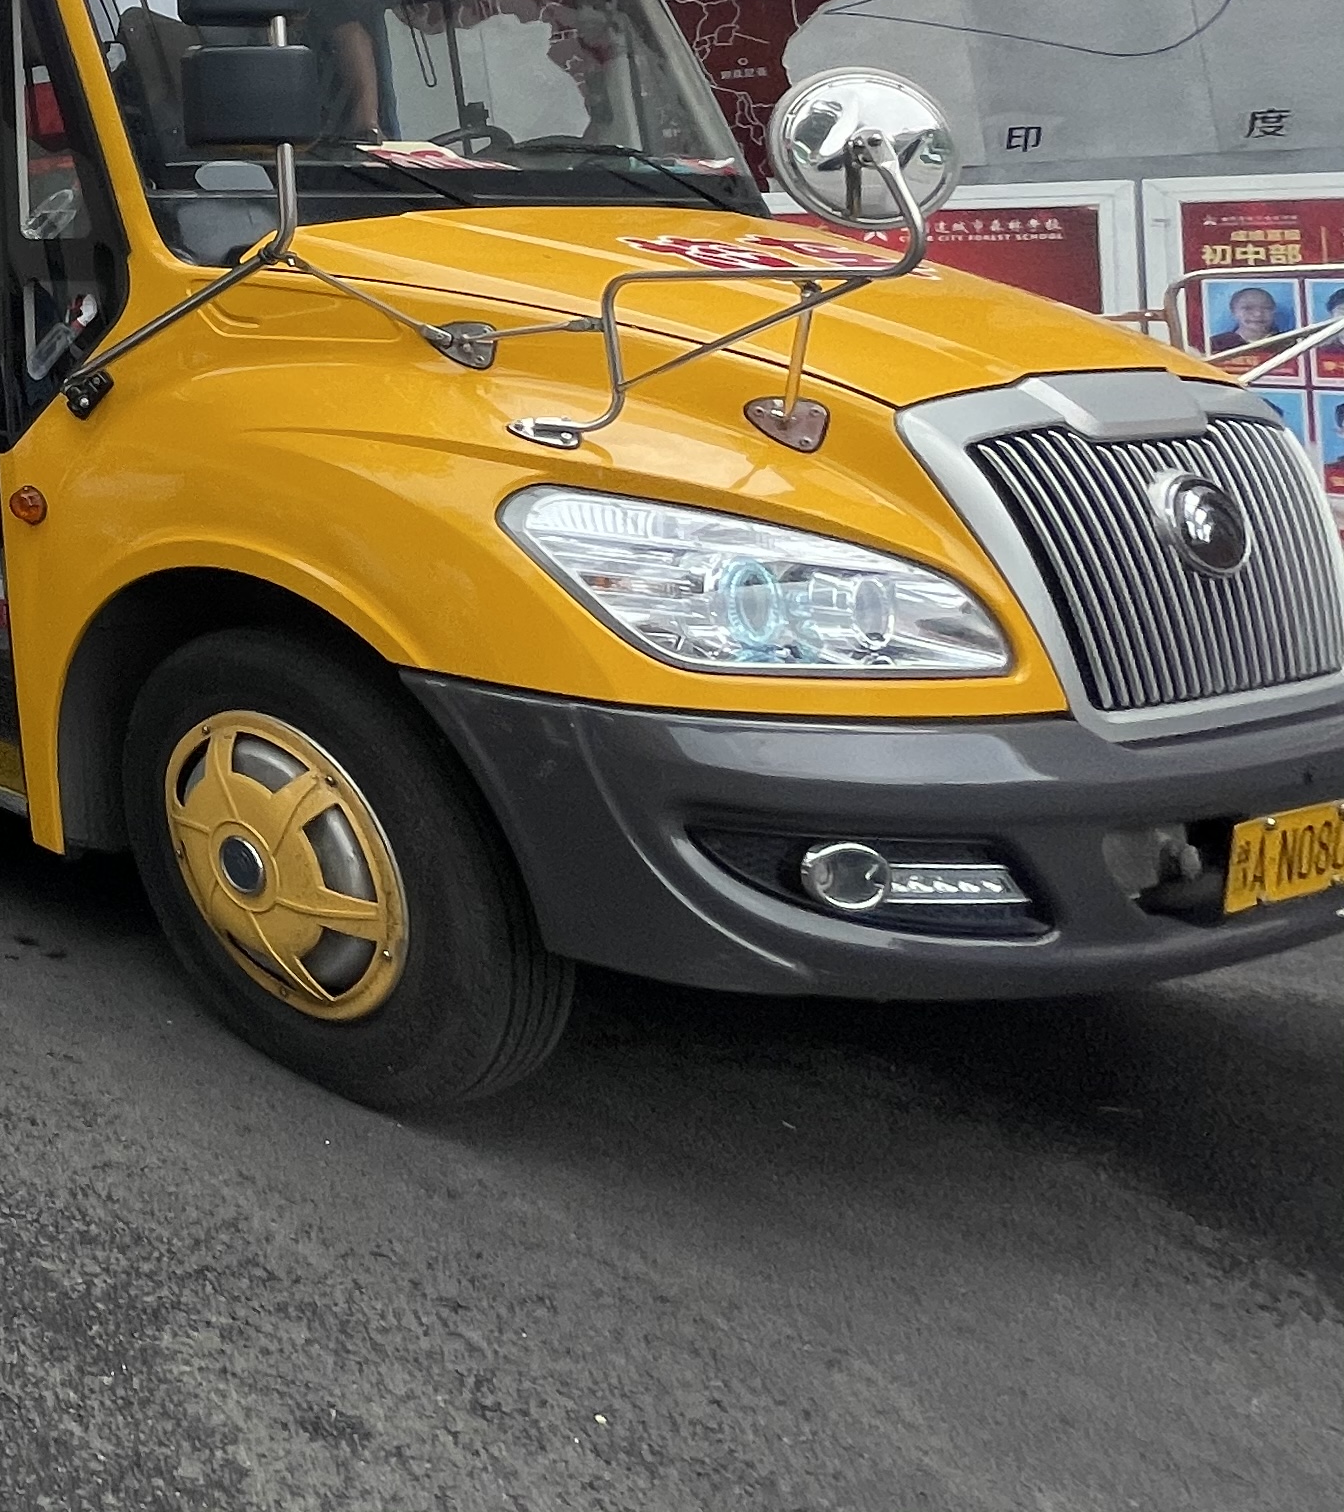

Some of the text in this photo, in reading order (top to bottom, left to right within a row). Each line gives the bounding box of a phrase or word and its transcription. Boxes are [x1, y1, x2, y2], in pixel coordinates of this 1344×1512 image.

[1243, 108, 1292, 139] 度
[1006, 126, 1042, 152] 印
[1201, 243, 1302, 266] 初中部
